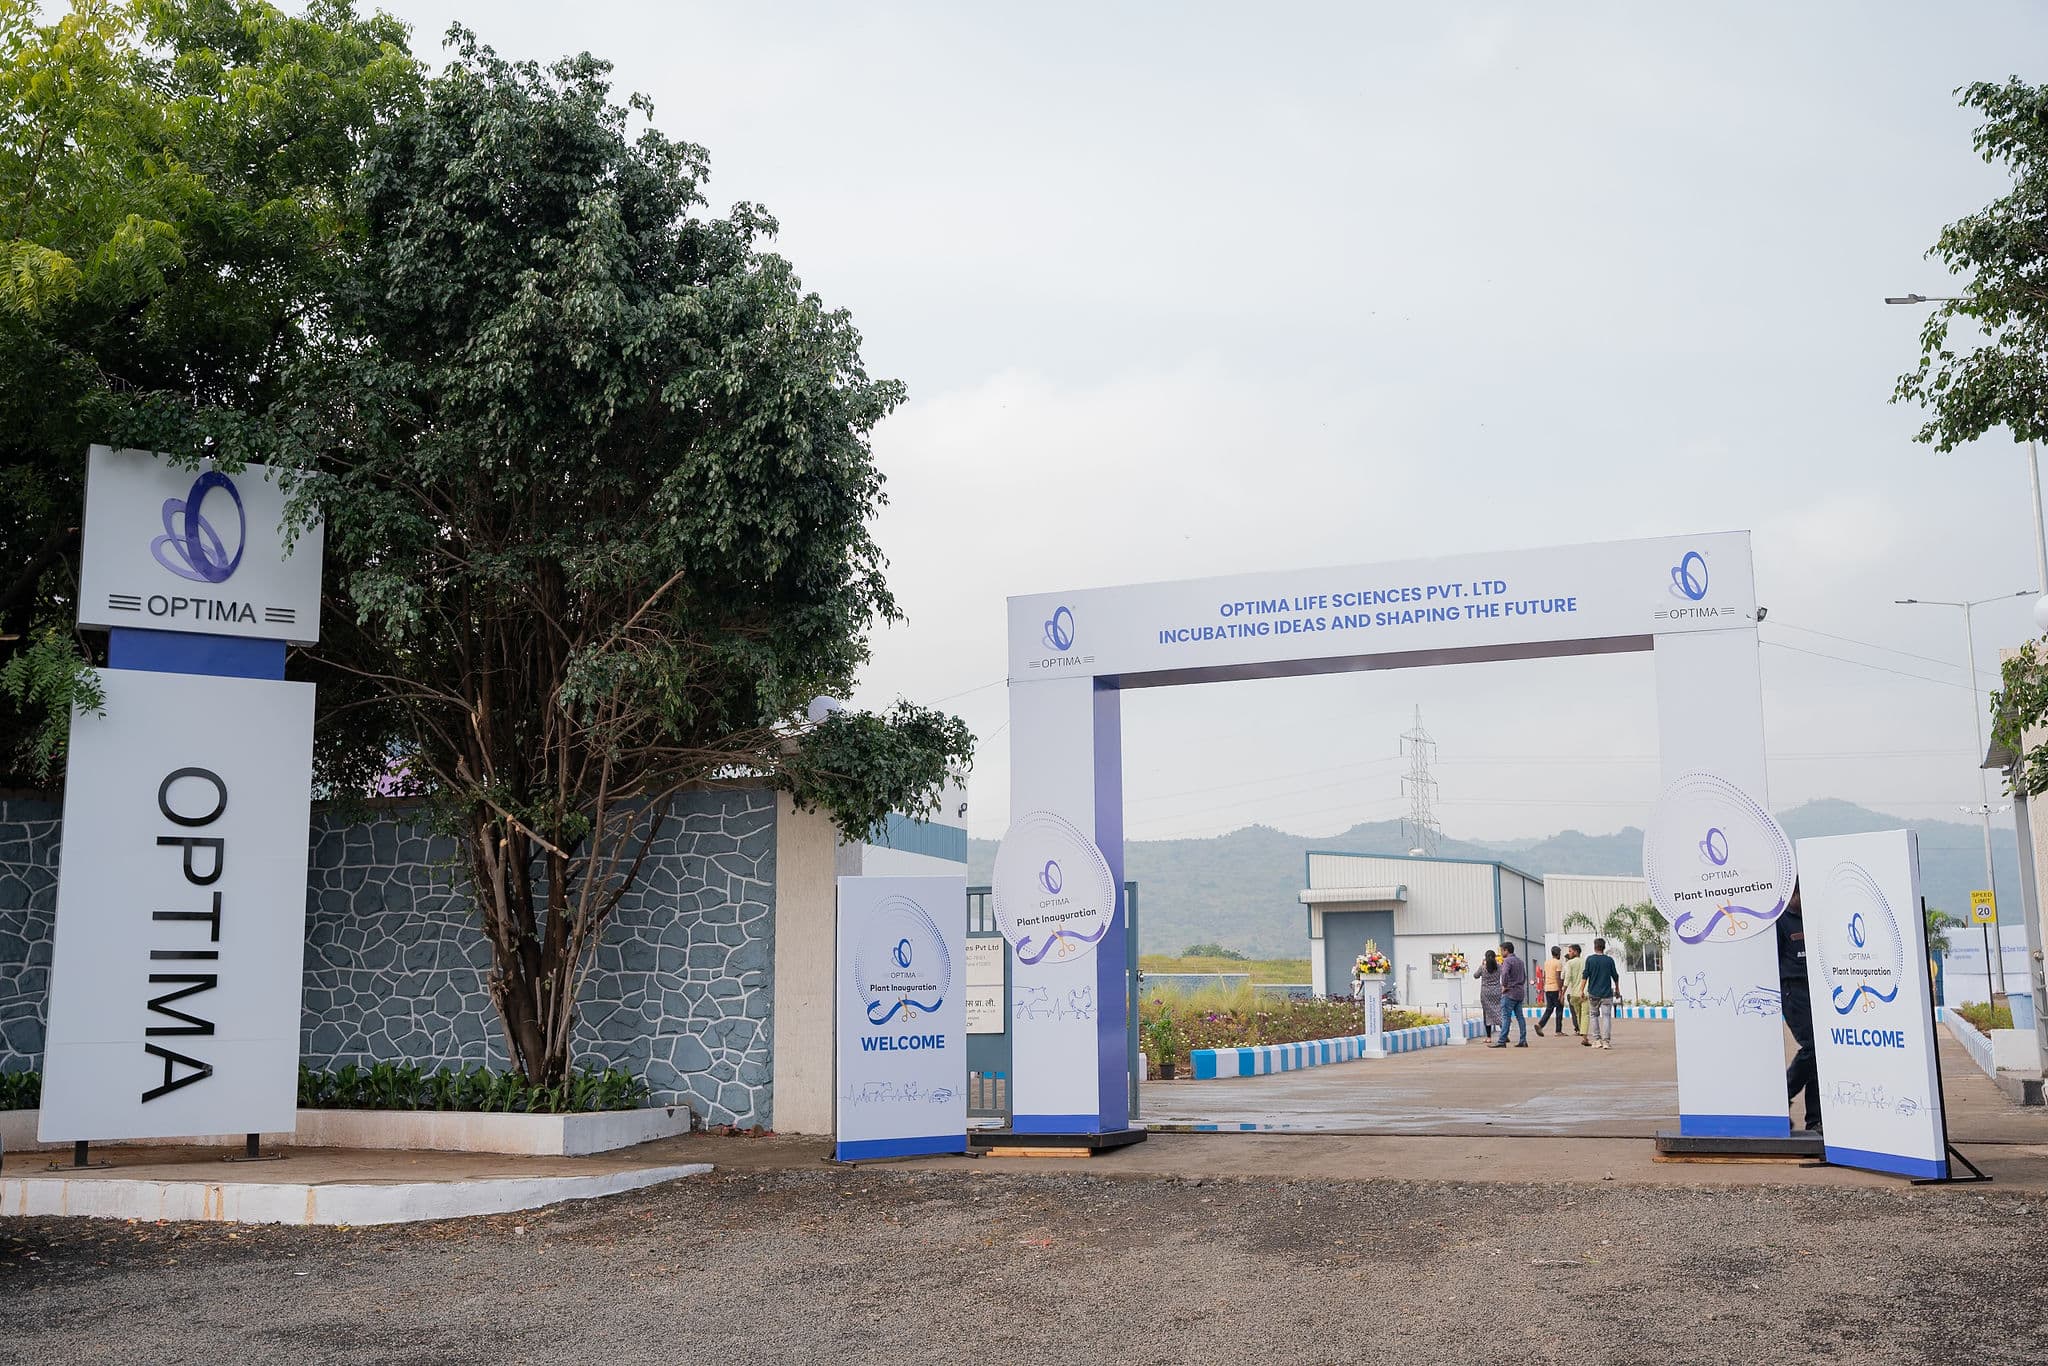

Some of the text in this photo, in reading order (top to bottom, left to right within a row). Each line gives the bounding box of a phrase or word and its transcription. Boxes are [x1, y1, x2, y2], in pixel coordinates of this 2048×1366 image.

[1219, 580, 1507, 617] OPTIMA LIFE SCIENCES PVT. LTD
[147, 594, 257, 624] OPTIMA
[1668, 607, 1719, 620] OPTIMA
[1159, 597, 1577, 644] INCUBATING IDEAS AND SHAPING THE FUTURE
[1041, 656, 1082, 669] OPTIMA
[1701, 869, 1739, 882] OPTIMA
[1674, 881, 1773, 902] Plant Inauguration
[1039, 898, 1070, 909] OPTIMA
[1016, 908, 1097, 927] Plant Inauguration
[1977, 907, 1990, 916] 20
[141, 767, 228, 1105] OPTIMA
[1848, 952, 1871, 961] OPTIMA
[1832, 967, 1892, 977] Plant Inauguration
[870, 983, 937, 993] Plant Inauguration
[861, 1034, 945, 1052] WELCOME
[1830, 1028, 1905, 1049] WELCOME
